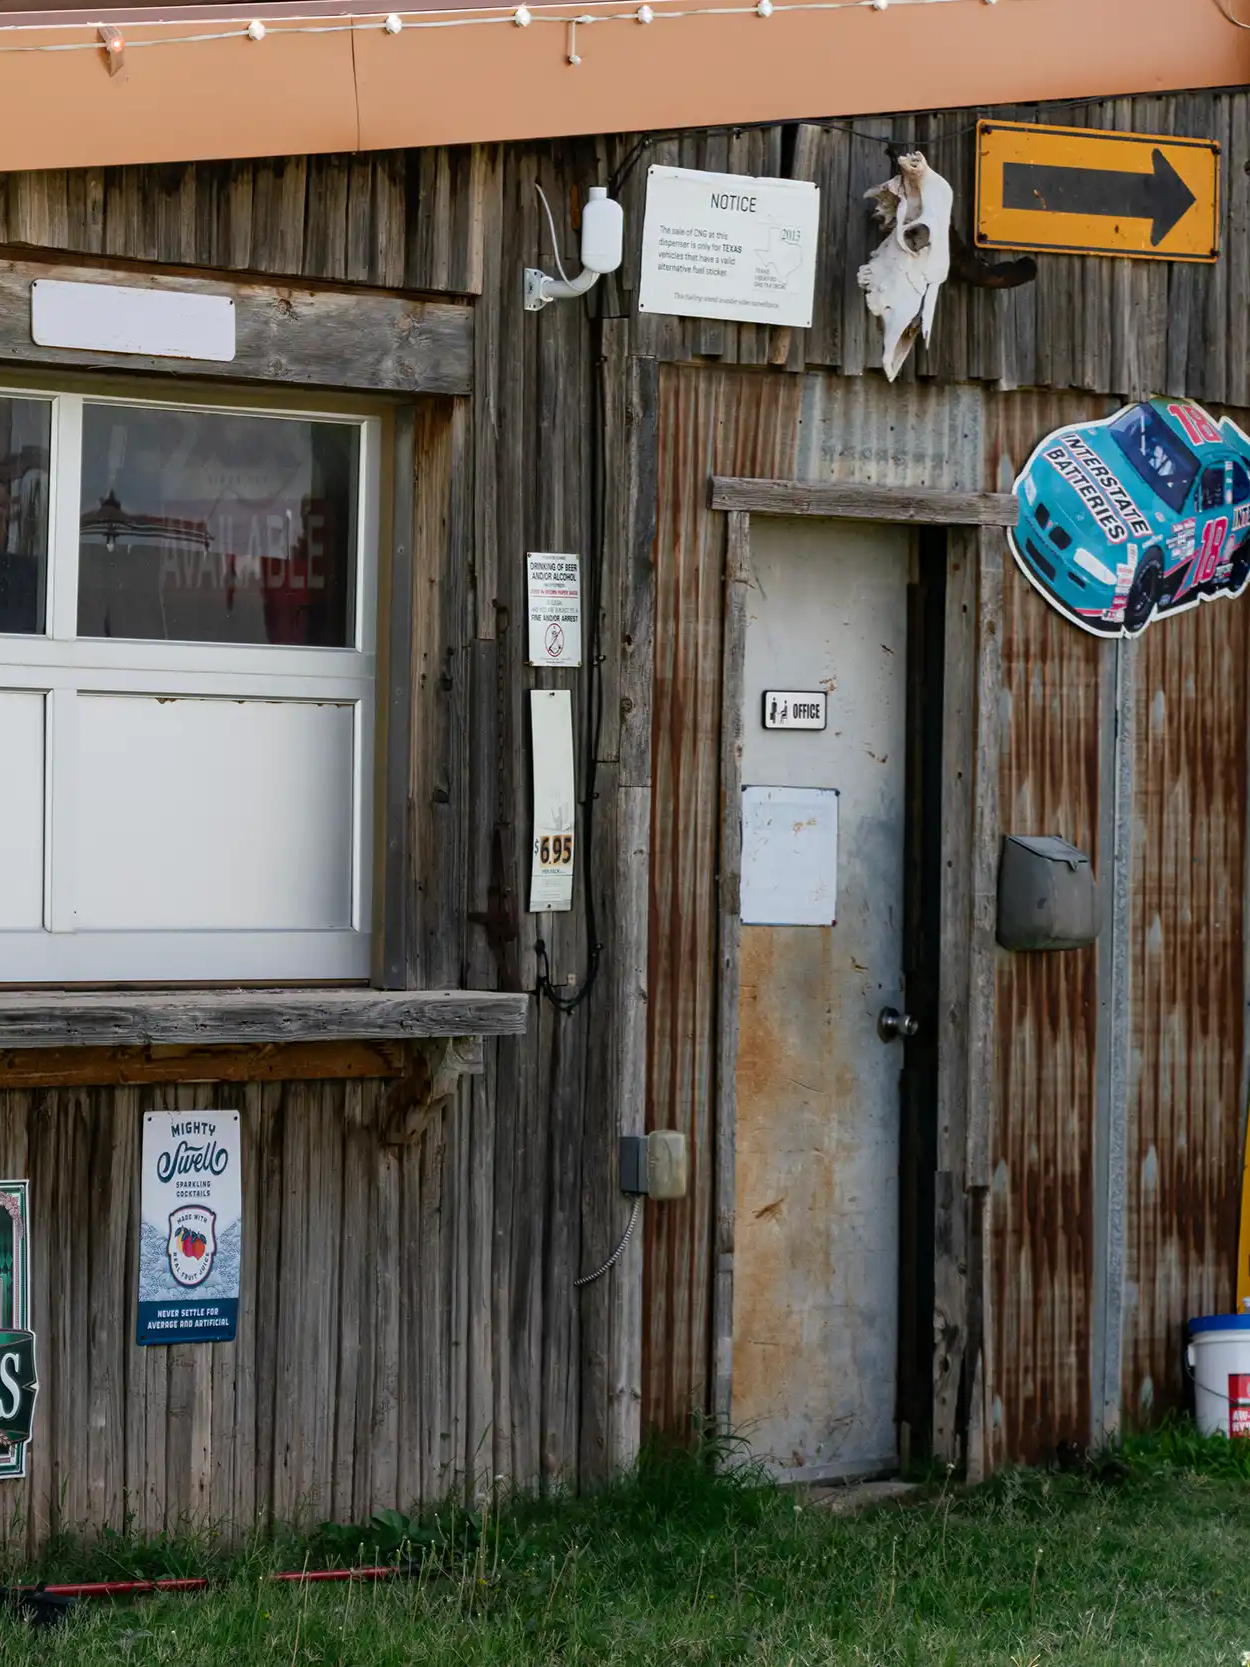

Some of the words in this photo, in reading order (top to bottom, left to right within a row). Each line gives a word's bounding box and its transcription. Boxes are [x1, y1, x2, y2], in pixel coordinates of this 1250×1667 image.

[710, 193, 757, 213] NOTICE
[660, 225, 671, 234] The
[671, 227, 686, 236] sale
[686, 228, 693, 237] of
[693, 228, 707, 238] CNG
[708, 230, 715, 239] at
[716, 231, 729, 240] this
[659, 238, 690, 249] dispenser
[690, 240, 696, 249] is
[697, 241, 711, 252] only
[712, 243, 722, 251] for
[722, 243, 743, 254] TEXAS
[658, 250, 683, 260] vehicles
[685, 252, 698, 261] that
[699, 254, 714, 263] have
[720, 256, 736, 265] valid
[657, 262, 692, 272] alternative
[692, 265, 705, 274] fuel
[1063, 434, 1151, 536] INTERSTATE
[1046, 447, 1127, 542] BATTERIES
[160, 513, 326, 590] AVAILABLE
[1191, 516, 1229, 588] 18
[530, 562, 556, 571] DRINKING
[557, 563, 564, 571] OF
[565, 563, 578, 571] BEER
[553, 573, 577, 581] ALCOHOL
[531, 614, 542, 622] FINE
[792, 703, 821, 719] OFFICE
[171, 1121, 216, 1138] MIGHTY
[157, 1140, 229, 1184] Swell
[176, 1180, 211, 1188] SPARKLING
[176, 1190, 211, 1198] COCKTAILS
[177, 1214, 192, 1224] MADE
[193, 1214, 208, 1223] WITH
[173, 1252, 181, 1272] REAL
[181, 1271, 197, 1281] FRUIT
[198, 1252, 210, 1275] JUICE
[157, 1309, 180, 1318] NEVER
[181, 1308, 205, 1317] SETTLE
[206, 1307, 219, 1316] FOR
[147, 1320, 178, 1330] AVERAGE
[194, 1318, 230, 1328] ARTIFICIAL
